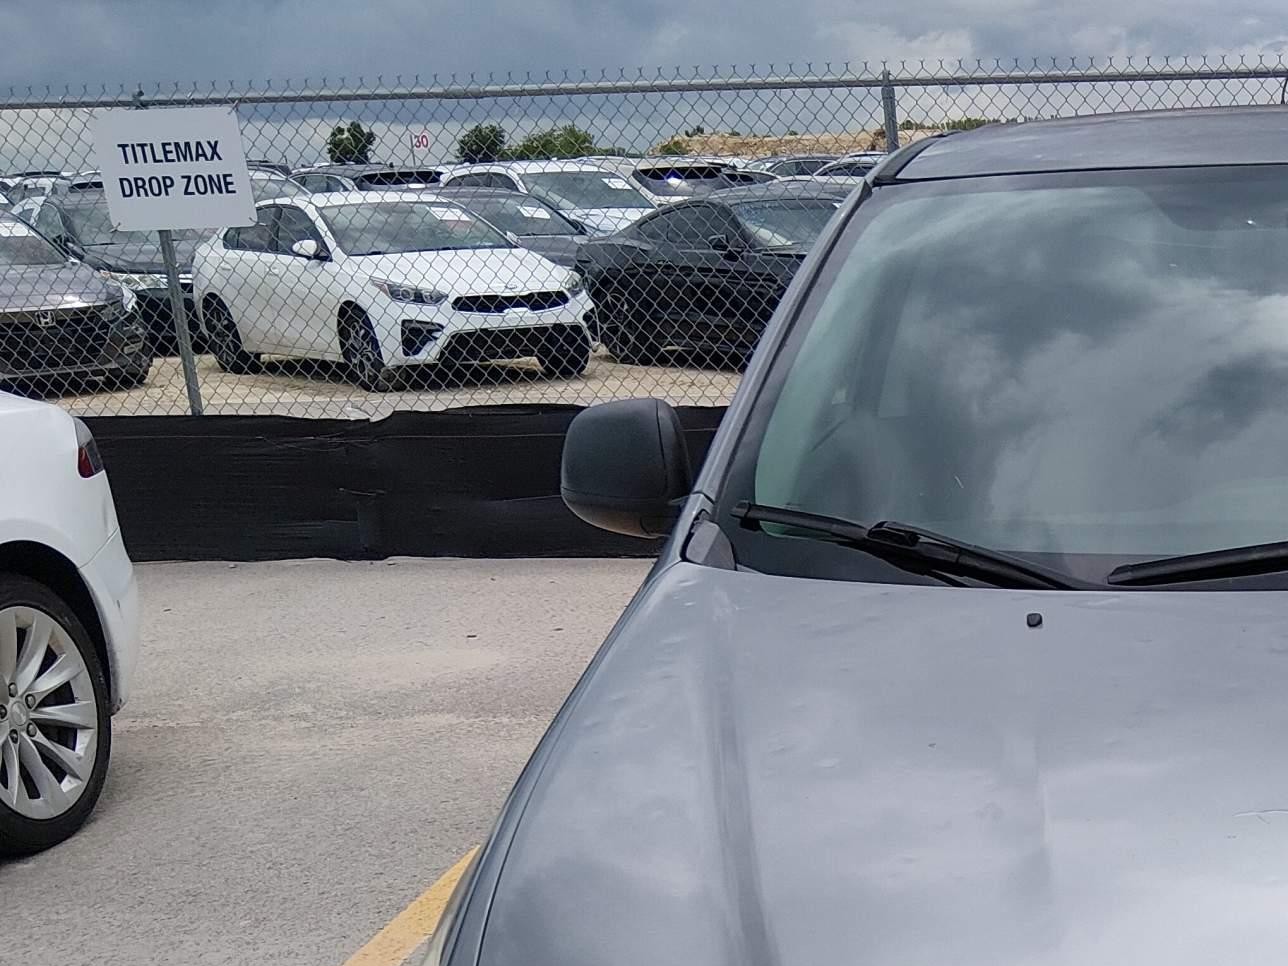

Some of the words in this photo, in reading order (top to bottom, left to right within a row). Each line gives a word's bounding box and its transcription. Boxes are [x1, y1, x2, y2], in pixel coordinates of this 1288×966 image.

[117, 140, 223, 165] TITLEMAX
[414, 134, 429, 149] 30
[118, 175, 175, 198] DROP
[181, 173, 237, 196] ZONE
